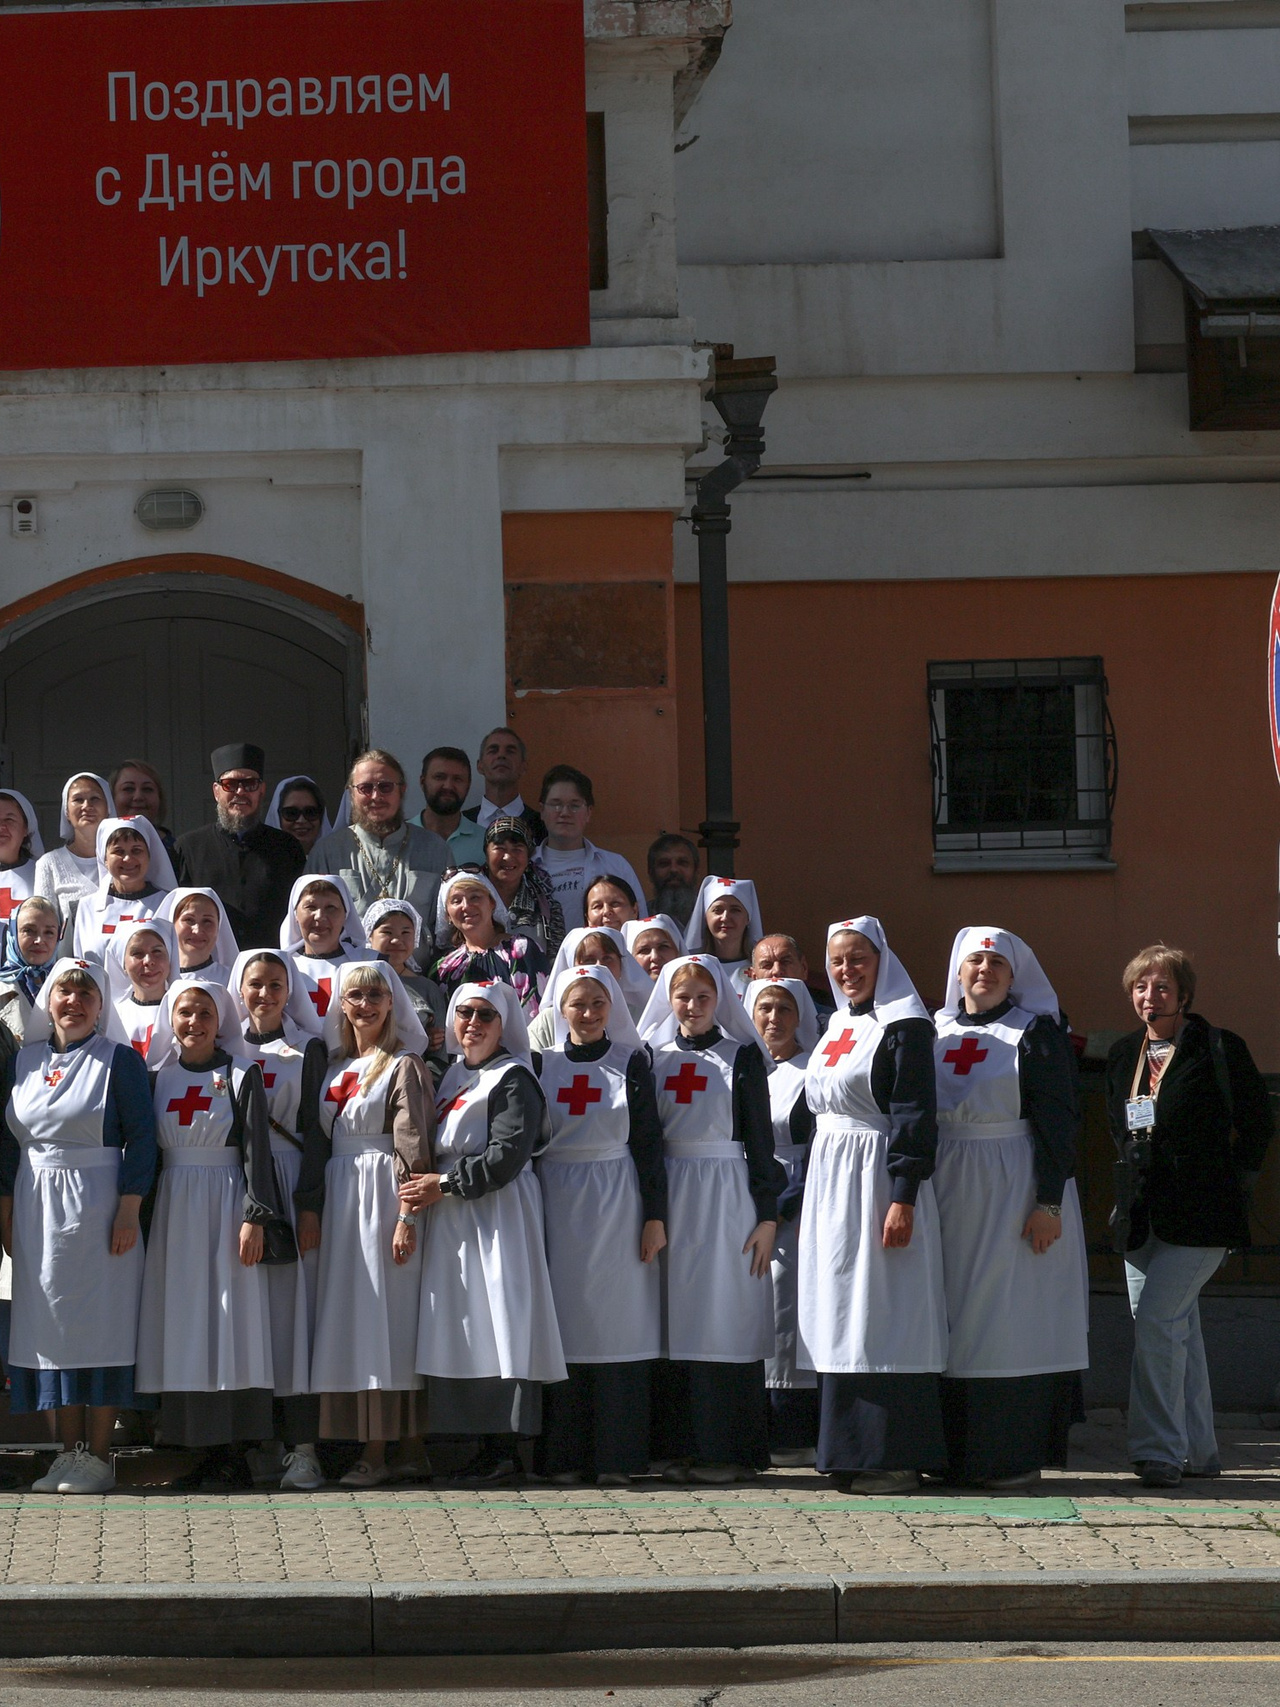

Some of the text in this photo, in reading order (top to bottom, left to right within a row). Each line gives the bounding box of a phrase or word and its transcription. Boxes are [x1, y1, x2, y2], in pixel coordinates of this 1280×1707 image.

[107, 71, 451, 129] Поздравляем
[96, 151, 466, 211] с Днём города
[159, 230, 408, 297] Иркутска!
